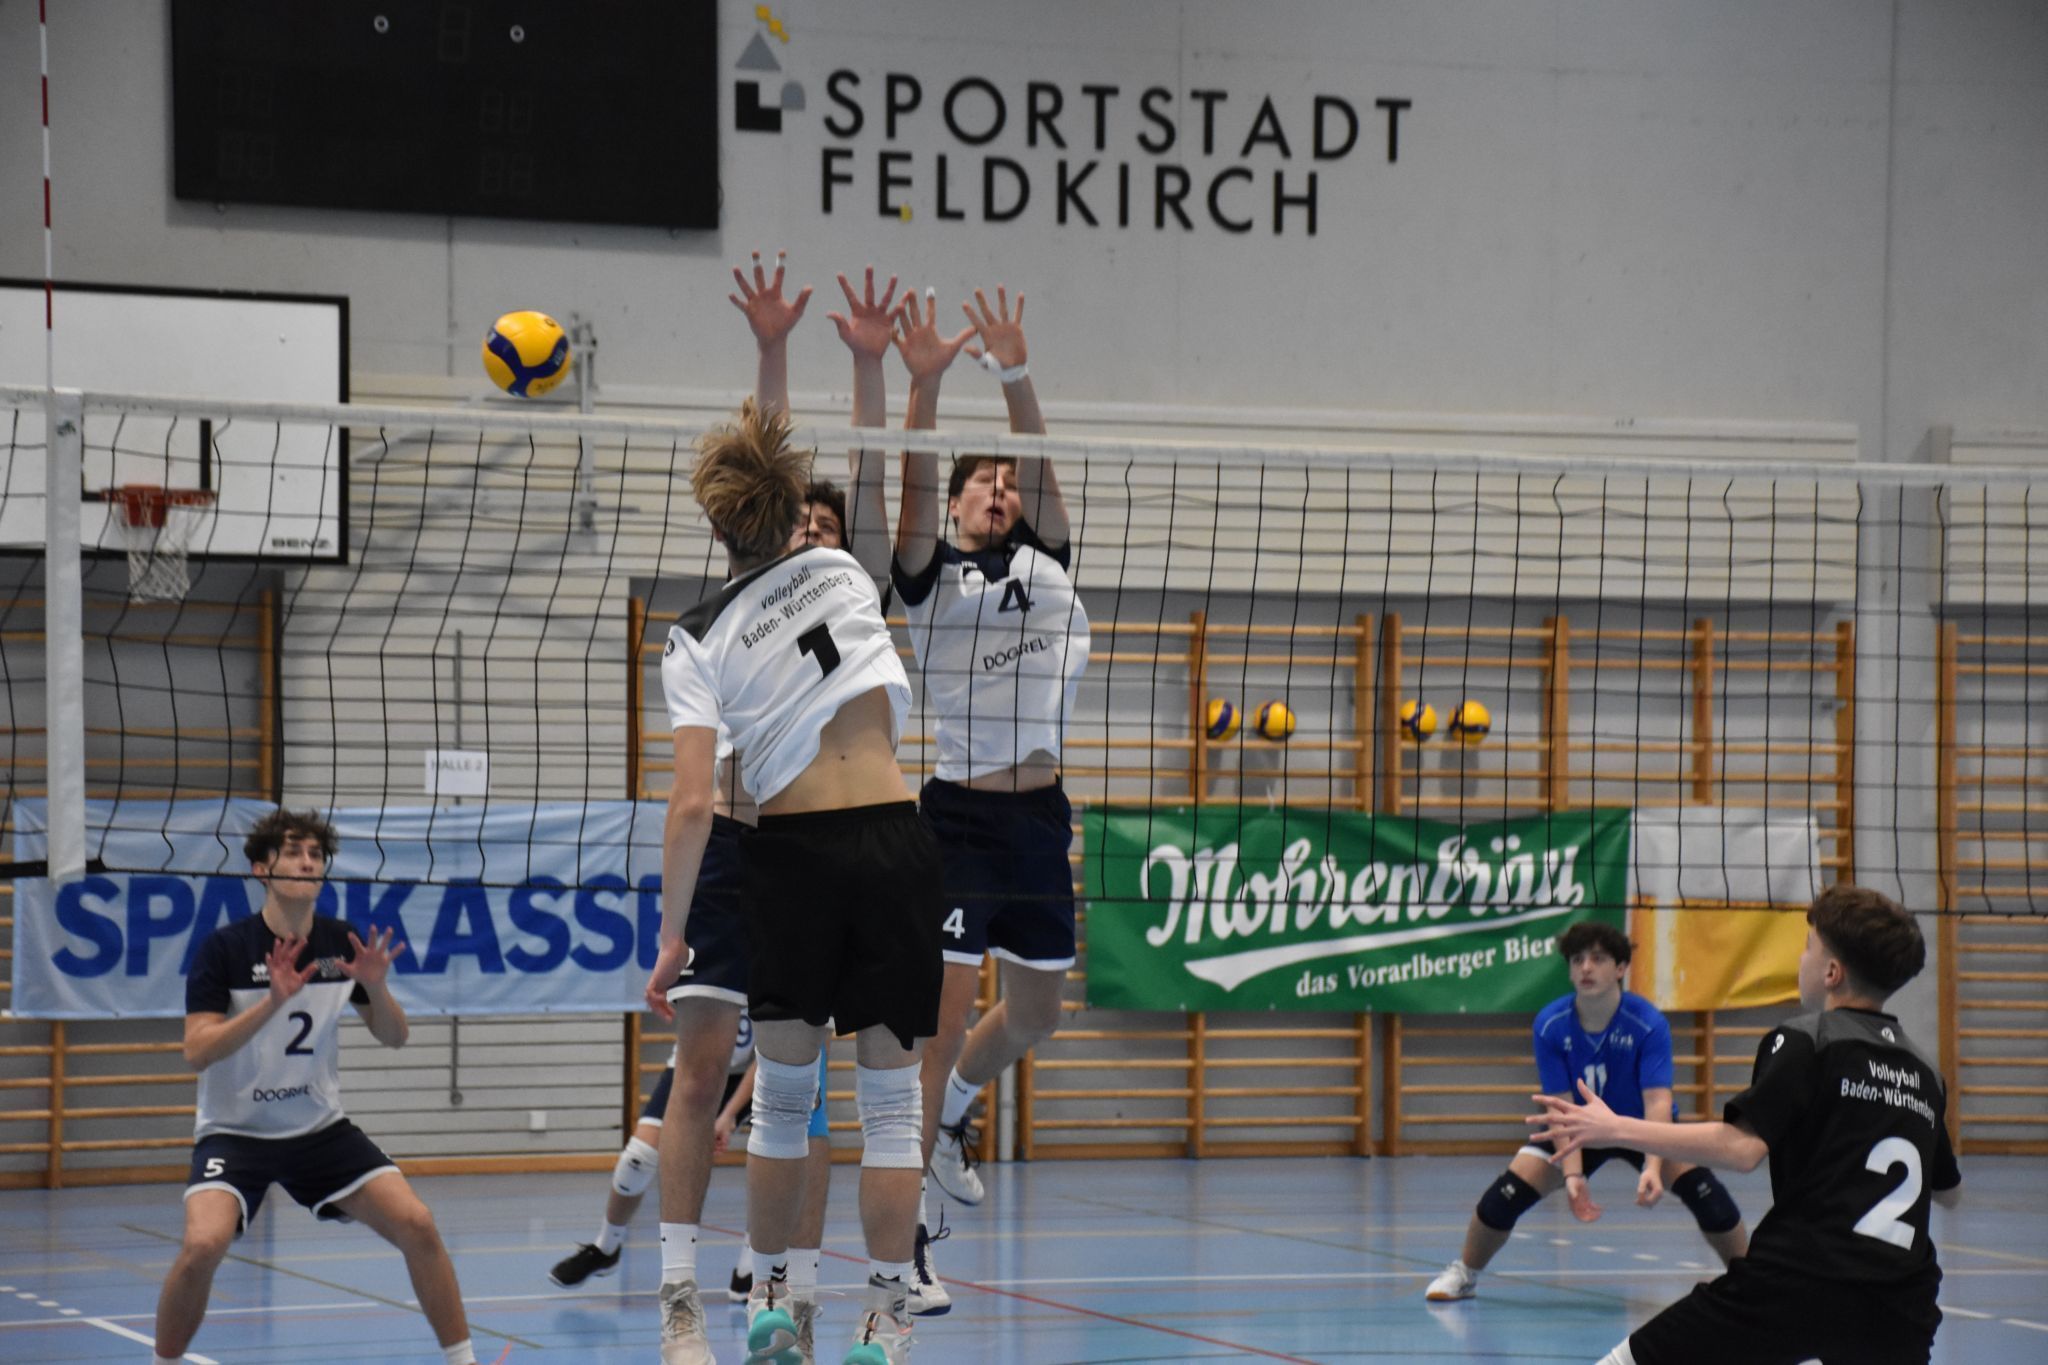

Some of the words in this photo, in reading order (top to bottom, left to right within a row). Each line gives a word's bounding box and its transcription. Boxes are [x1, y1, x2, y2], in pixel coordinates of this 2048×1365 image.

[823, 68, 1413, 164] SPORTSTADT
[821, 147, 1318, 236] FELDKIRCH
[998, 577, 1035, 613] 4
[797, 622, 841, 680] 1
[1139, 834, 1585, 947] Mohrenbräu
[51, 873, 662, 978] SPAKASSE
[942, 908, 965, 939] 4
[1296, 971, 1338, 997] das
[1347, 948, 1497, 989] Vorarlberger
[1503, 934, 1556, 964] Bier
[284, 1010, 314, 1057] 2
[1868, 1059, 1920, 1093] Volleyball
[203, 1157, 226, 1178] 5
[1852, 1136, 1923, 1251] 2
